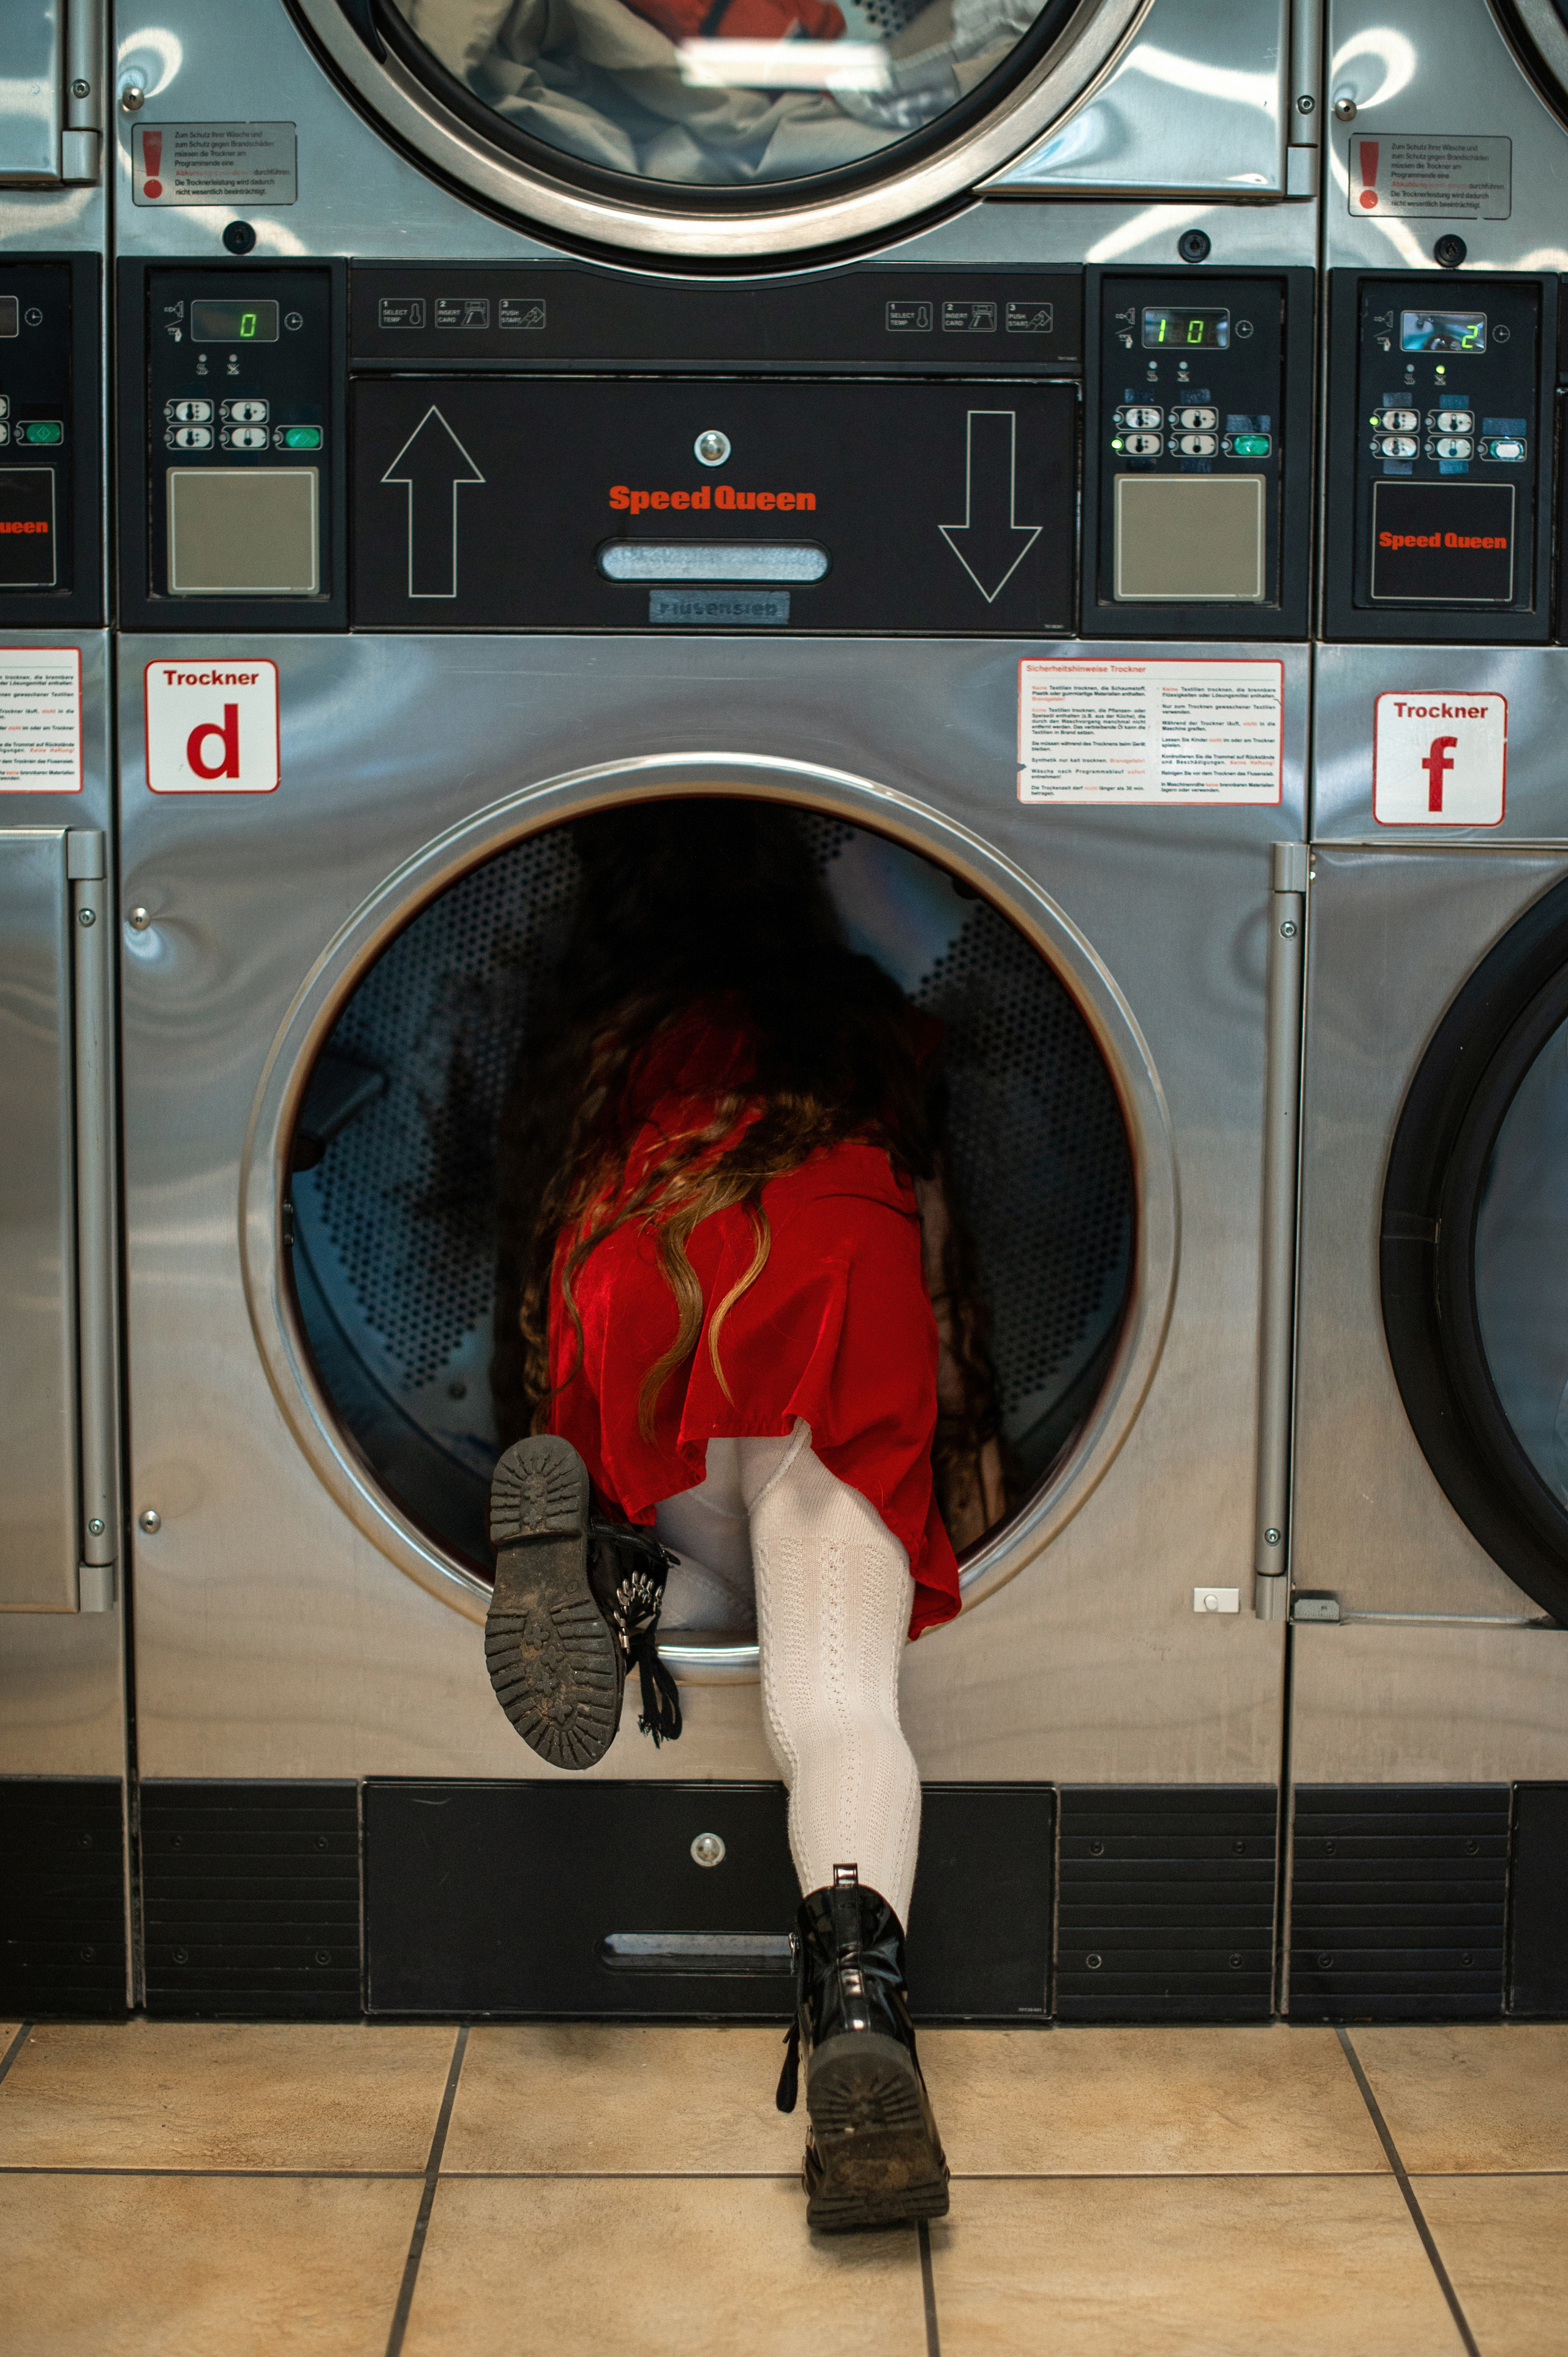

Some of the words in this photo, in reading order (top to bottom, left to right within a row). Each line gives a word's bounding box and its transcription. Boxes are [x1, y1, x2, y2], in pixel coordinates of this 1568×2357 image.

[240, 314, 257, 337] 0
[1461, 325, 1479, 349] 2
[609, 485, 710, 515] Speed
[715, 485, 816, 511] Queen
[1379, 531, 1441, 550] Speed
[1444, 532, 1507, 549] Queen
[163, 670, 259, 686] Trockner
[1393, 702, 1488, 719] Trockner
[186, 703, 239, 780] d
[1422, 736, 1458, 812] f
